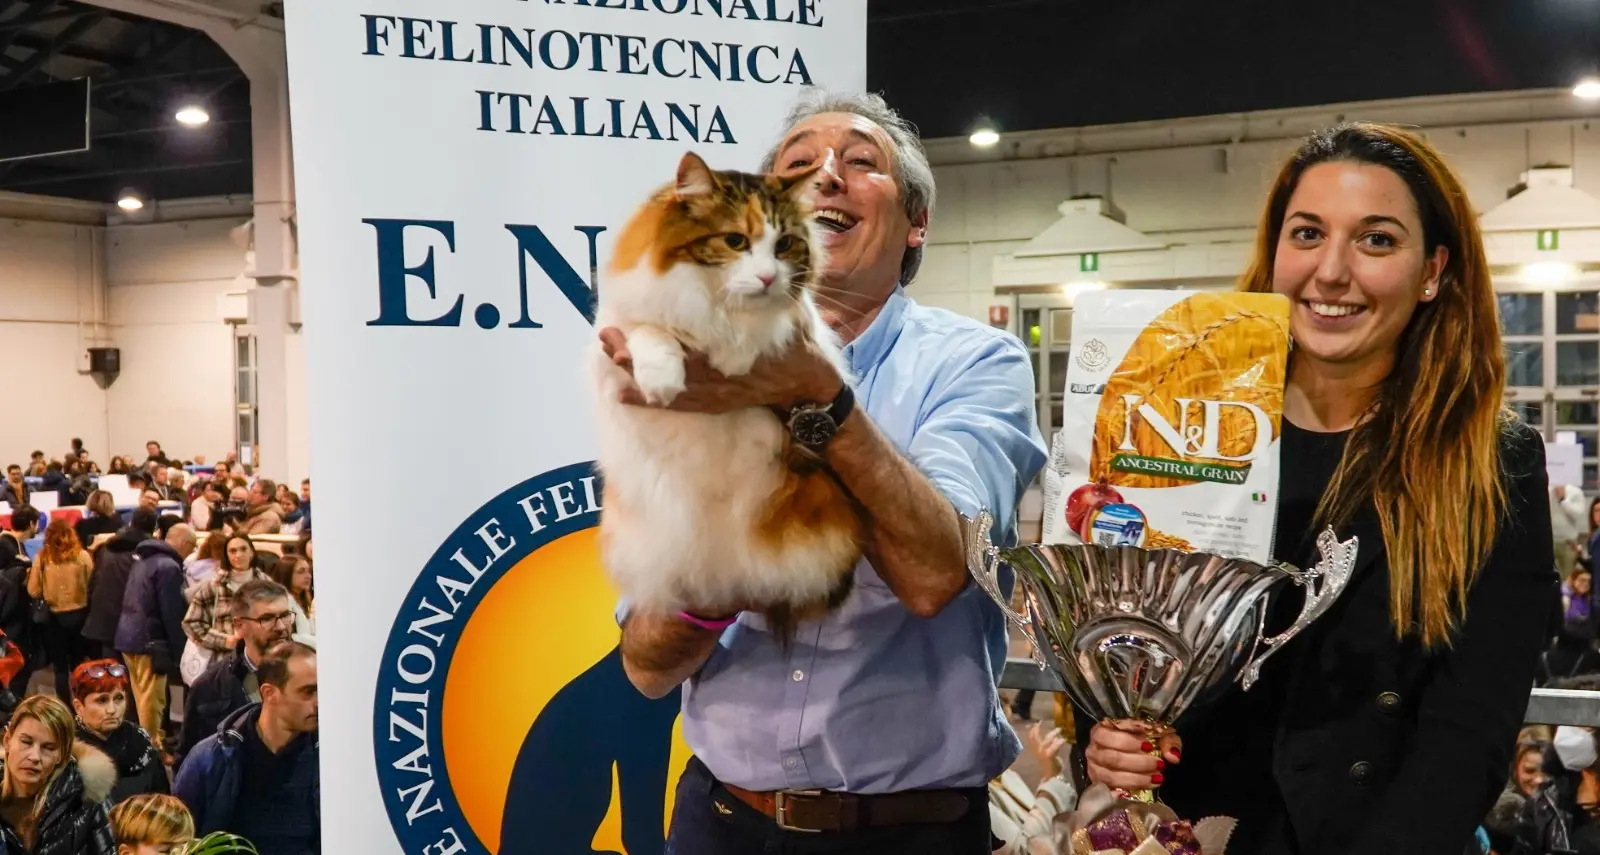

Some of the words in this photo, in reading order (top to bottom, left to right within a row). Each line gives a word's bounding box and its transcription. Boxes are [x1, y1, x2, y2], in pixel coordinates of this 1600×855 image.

[361, 14, 814, 86] FELINOTECNICA
[475, 90, 738, 145] ITALIANA
[1118, 394, 1273, 461] N&D
[1117, 457, 1199, 476] ANCESTRAL
[1202, 466, 1245, 481] GRAIN
[389, 517, 517, 826] NAZIONALE
